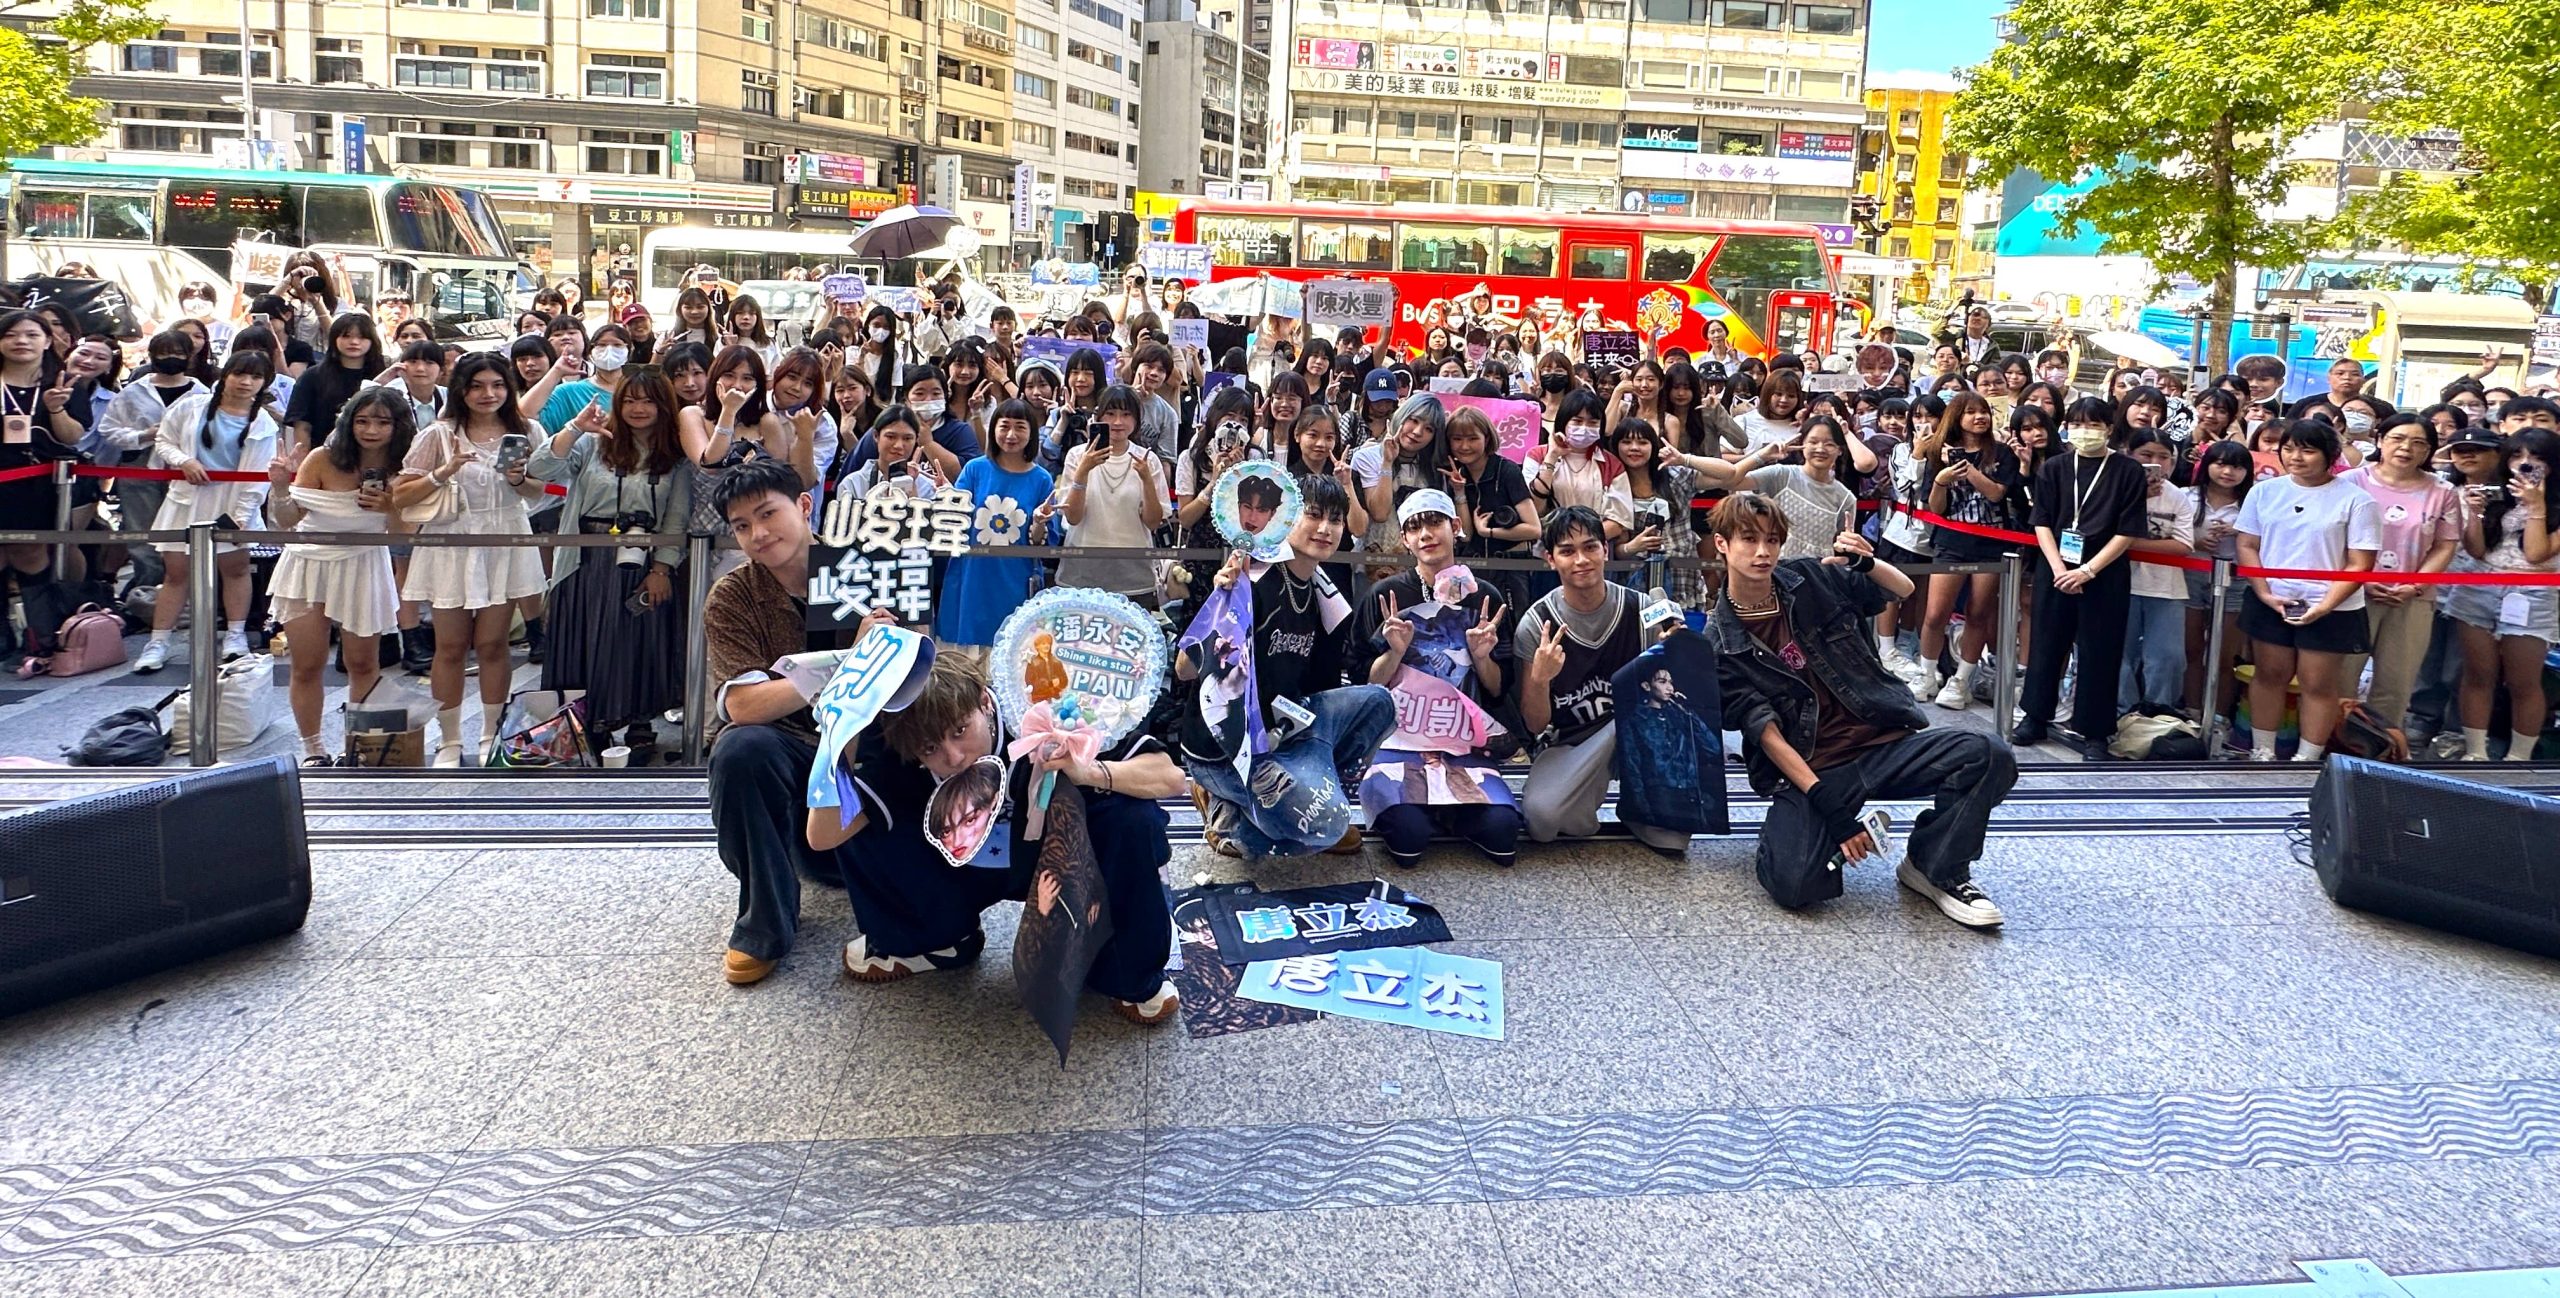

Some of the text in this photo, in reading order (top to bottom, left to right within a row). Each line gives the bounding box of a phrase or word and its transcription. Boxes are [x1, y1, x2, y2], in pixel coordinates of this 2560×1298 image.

[1345, 74, 1425, 94] 美的髮業
[1020, 197, 1028, 228] STREET
[1315, 291, 1383, 316] 陳水豐
[1584, 333, 1637, 351] 唐立杰
[1588, 351, 1619, 369] 未來
[1497, 414, 1530, 449] 安
[823, 481, 975, 557] 峻瑋
[808, 547, 933, 622] 峻瑋
[1055, 614, 1146, 660] 潘永安
[1057, 648, 1132, 673] Shine like star
[1073, 670, 1135, 699] PAN
[1235, 896, 1418, 944] 唐立杰
[1267, 953, 1491, 1024] 唐立杰
